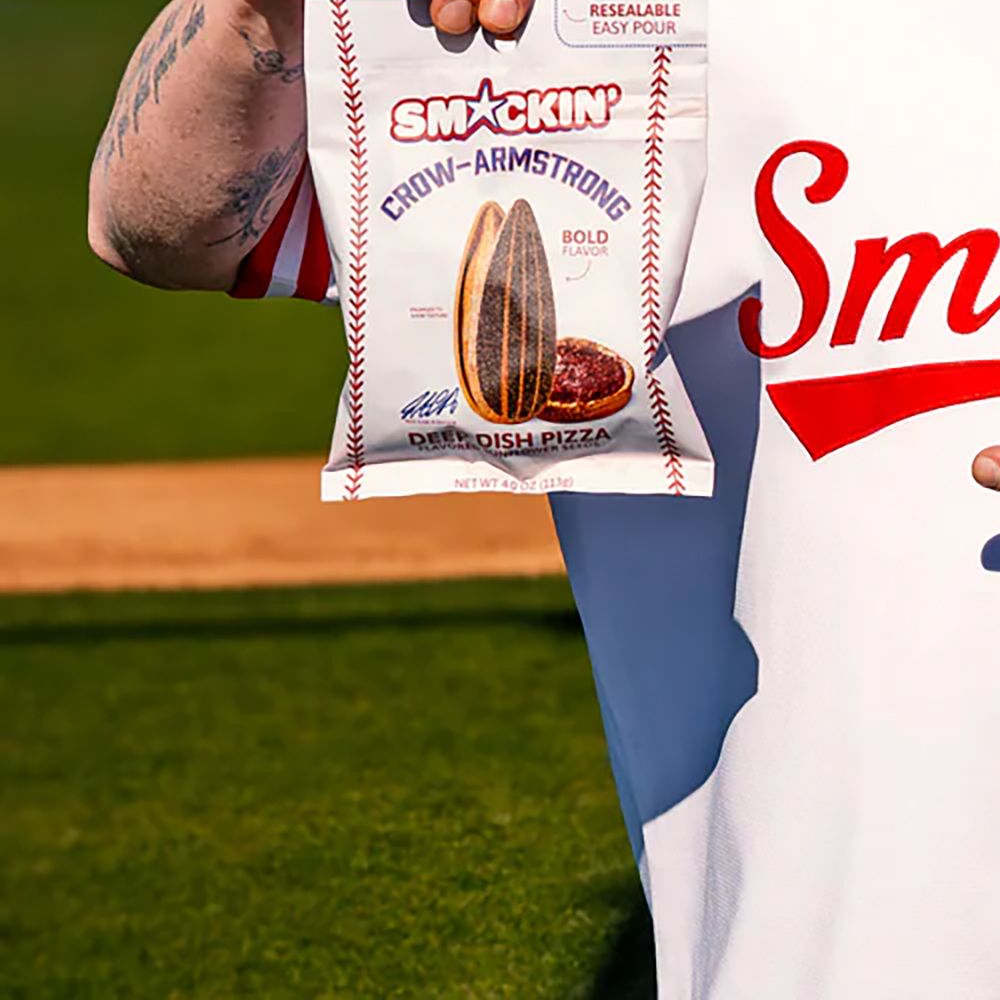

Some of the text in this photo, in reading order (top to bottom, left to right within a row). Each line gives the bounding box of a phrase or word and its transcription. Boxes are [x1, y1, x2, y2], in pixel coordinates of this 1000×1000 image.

[589, 3, 681, 17] RESEALABLE
[592, 20, 677, 35] EASY POUR
[380, 146, 632, 222] CROW-ARMSTRONG
[562, 229, 609, 244] BOLD
[562, 246, 609, 257] FLAVOR
[408, 427, 612, 449] DEEP DISH PIZZA
[454, 478, 477, 489] NET
[480, 478, 499, 489] WT
